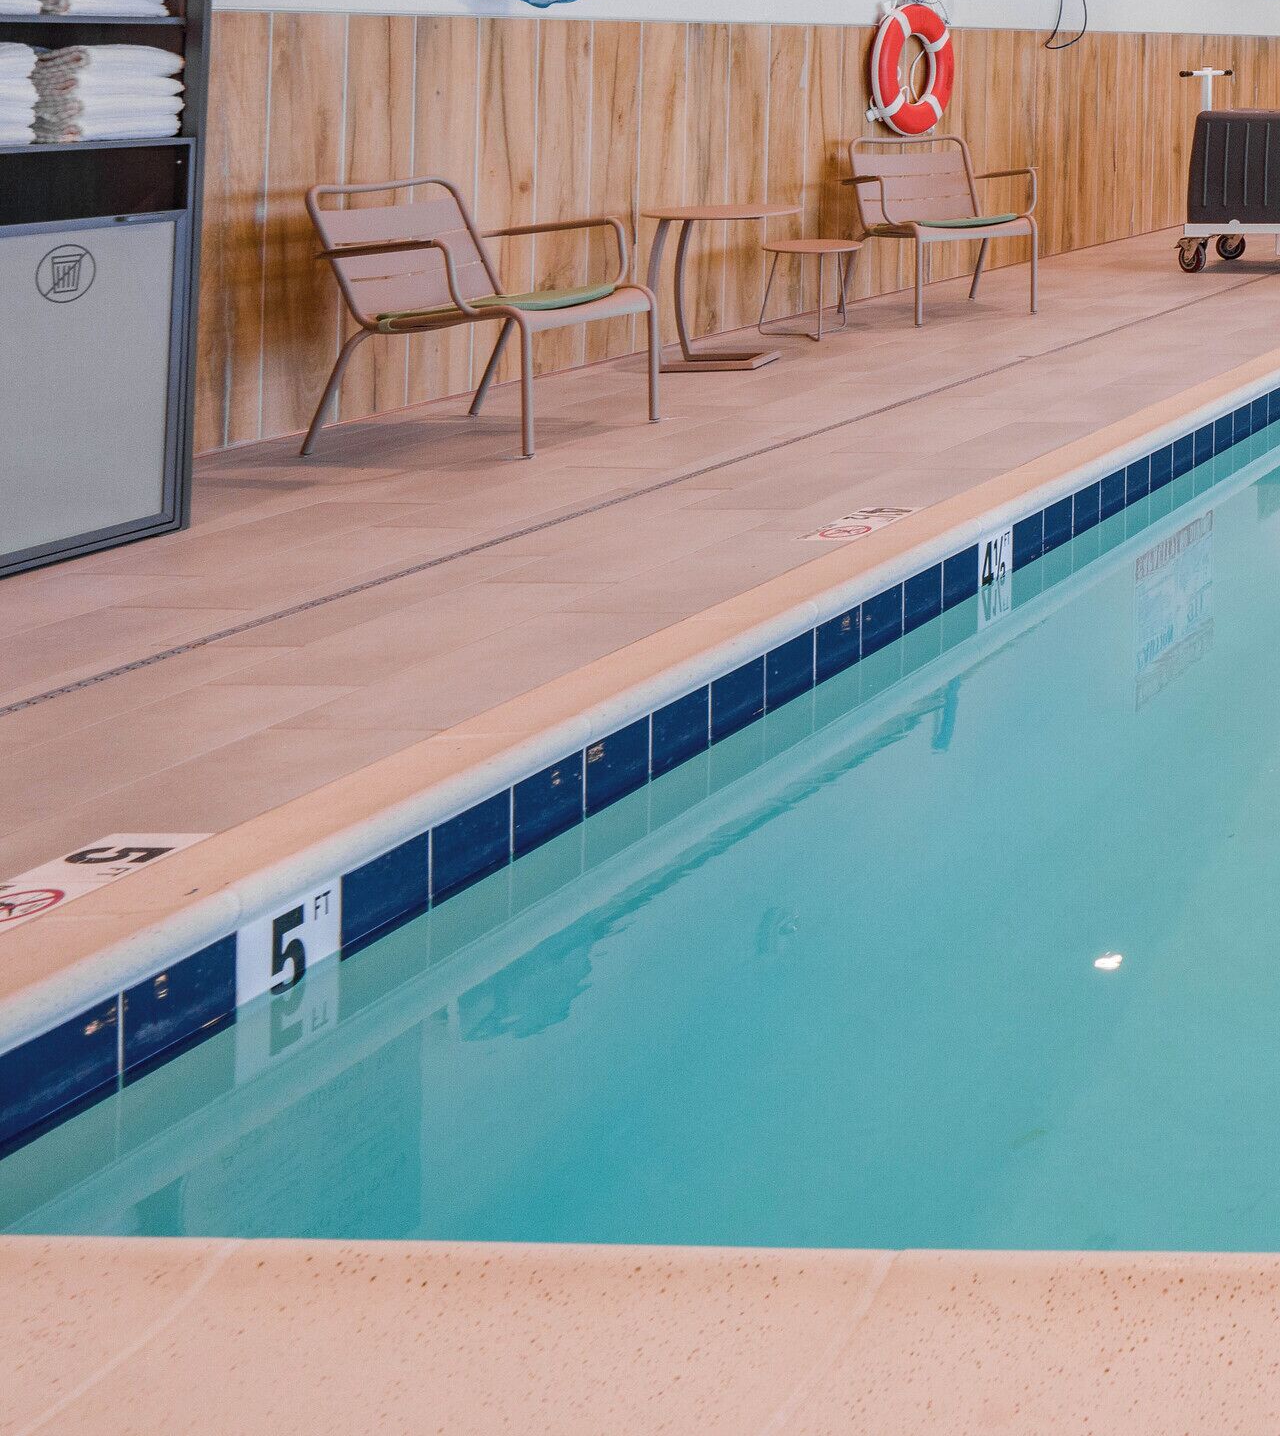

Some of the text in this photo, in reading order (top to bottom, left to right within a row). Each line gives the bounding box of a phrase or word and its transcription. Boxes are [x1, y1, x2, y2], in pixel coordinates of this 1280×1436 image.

[64, 846, 176, 864] 5
[270, 890, 331, 995] 5 FT
